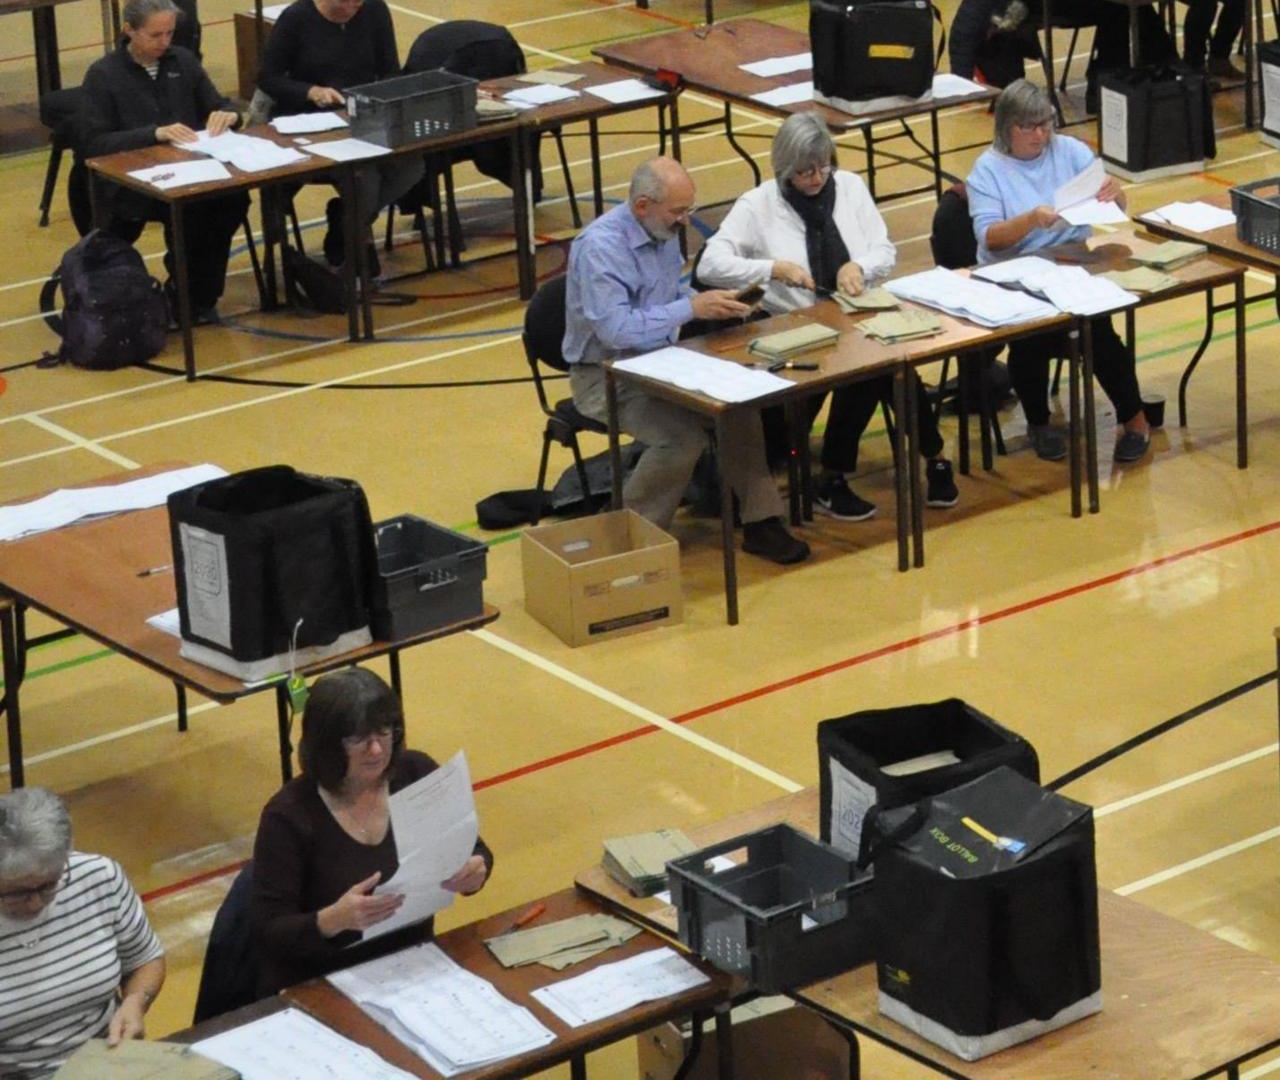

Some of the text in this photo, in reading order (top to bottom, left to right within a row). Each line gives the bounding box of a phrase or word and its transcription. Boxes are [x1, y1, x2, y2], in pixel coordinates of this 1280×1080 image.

[843, 809, 862, 830] 202
[929, 826, 979, 865] BALLOT BOX
